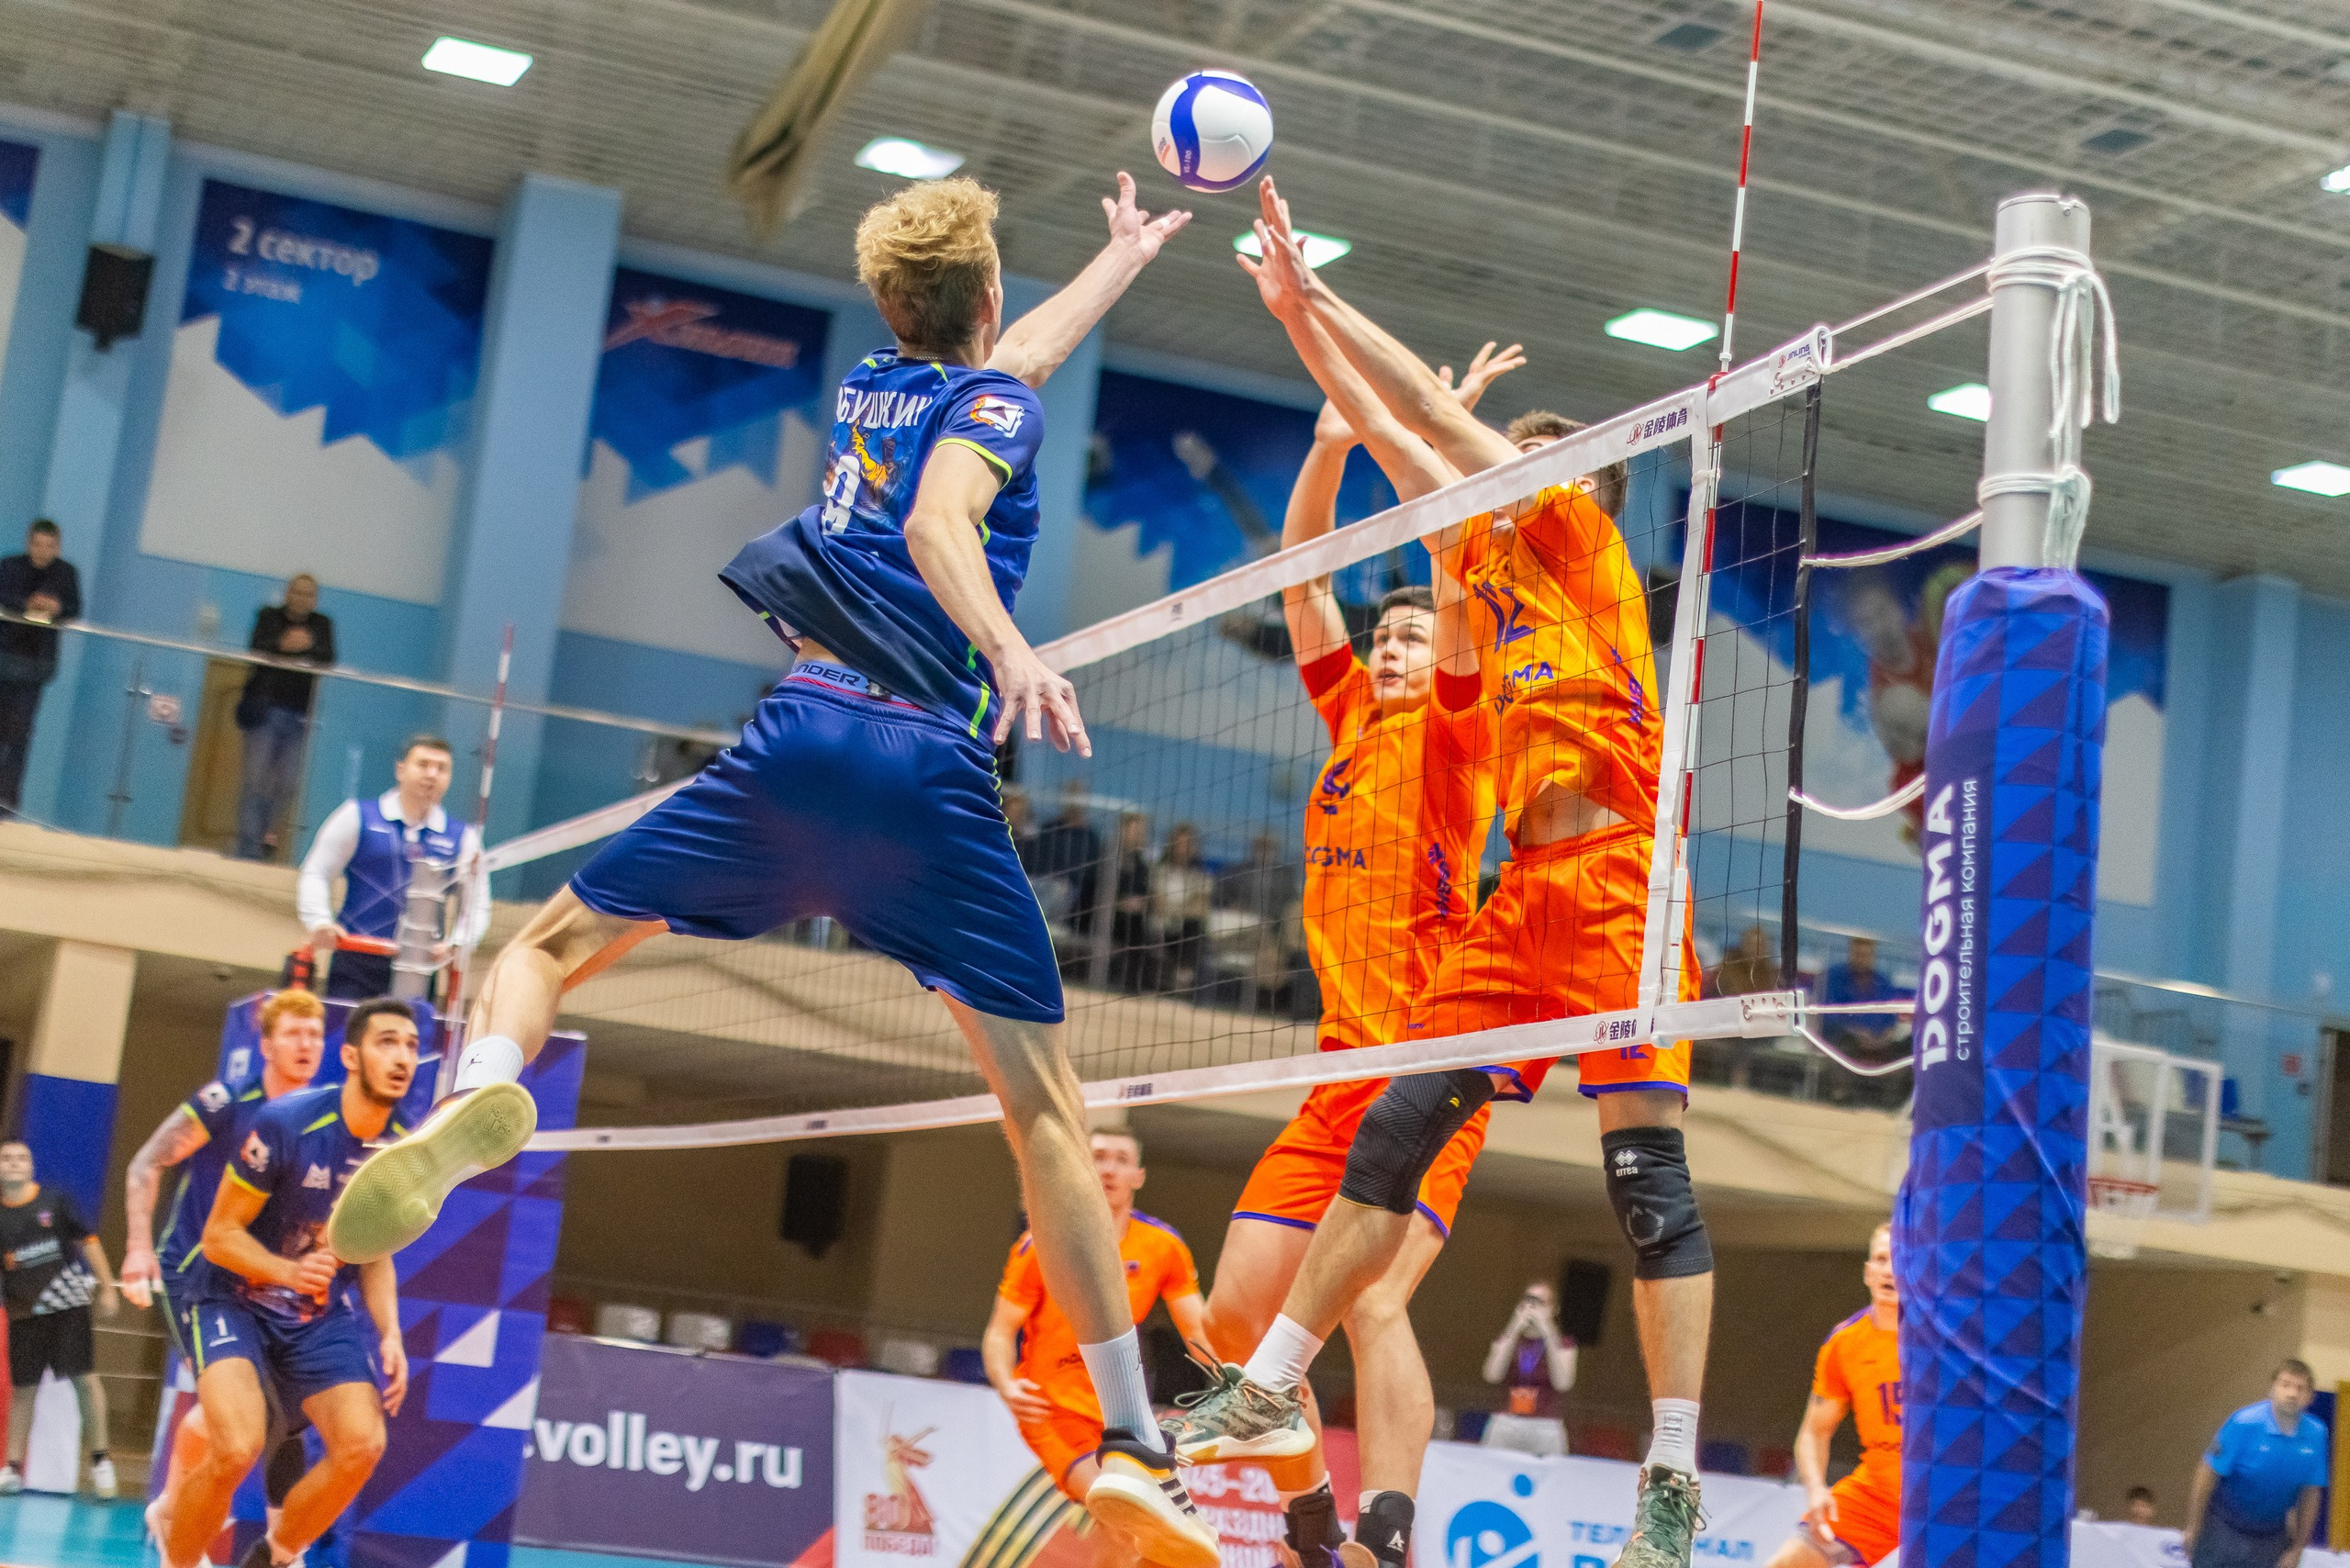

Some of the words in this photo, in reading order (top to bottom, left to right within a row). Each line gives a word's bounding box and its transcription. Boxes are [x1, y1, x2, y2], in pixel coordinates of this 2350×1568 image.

[229, 216, 253, 255] 2
[258, 230, 379, 287] сектор
[1642, 408, 1687, 440] 金陵体育
[1962, 780, 1977, 892] компания
[1922, 784, 1953, 1071] DOGMA
[1957, 897, 1974, 1061] строительная
[1616, 1166, 1639, 1177] errea
[215, 1316, 228, 1337] 1
